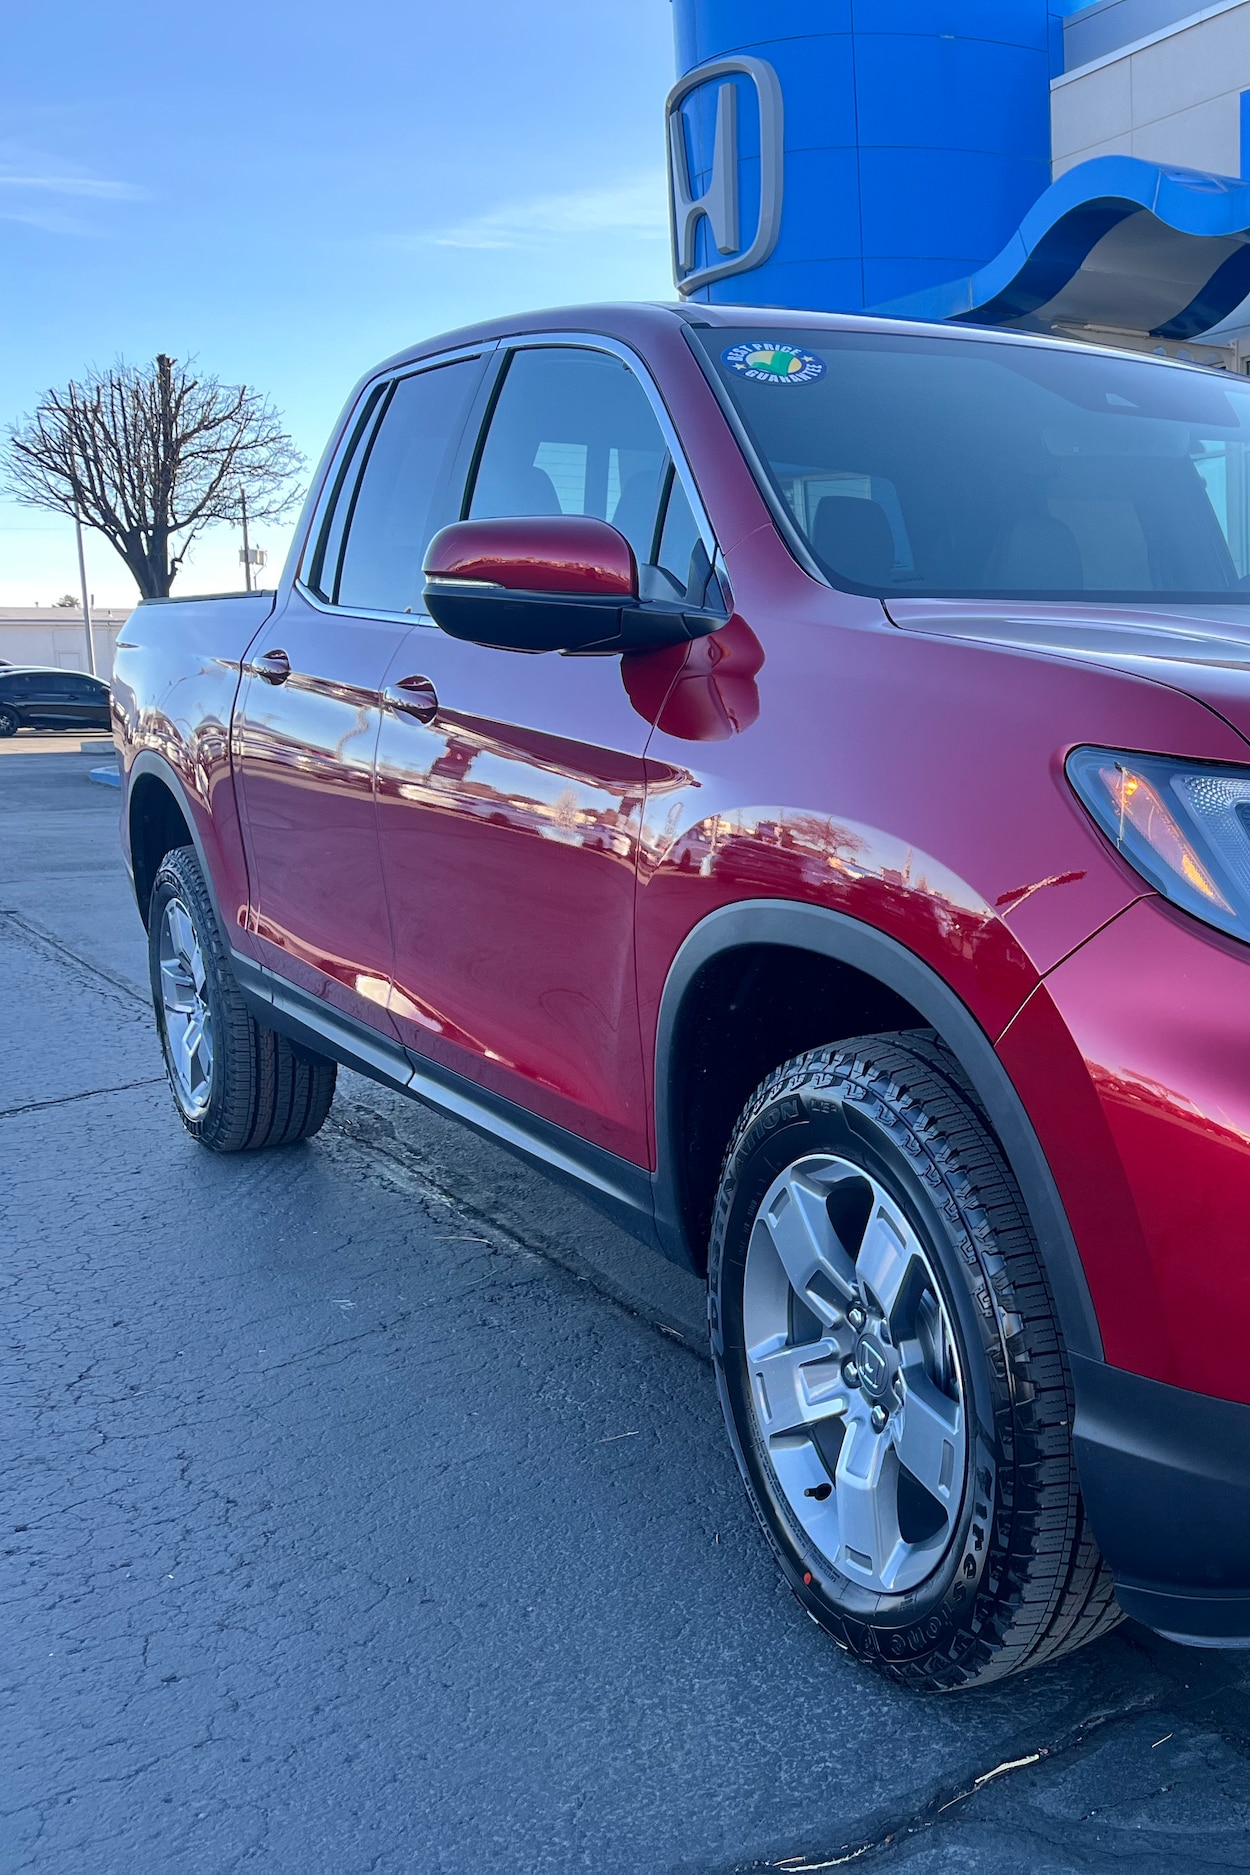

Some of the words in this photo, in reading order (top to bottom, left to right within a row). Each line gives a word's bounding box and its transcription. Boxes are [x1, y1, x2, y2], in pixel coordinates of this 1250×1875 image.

[726, 345, 754, 362] BEST
[751, 343, 803, 356] PRICE
[744, 363, 823, 384] GUARANTEE
[709, 1098, 800, 1331] DESTINATION
